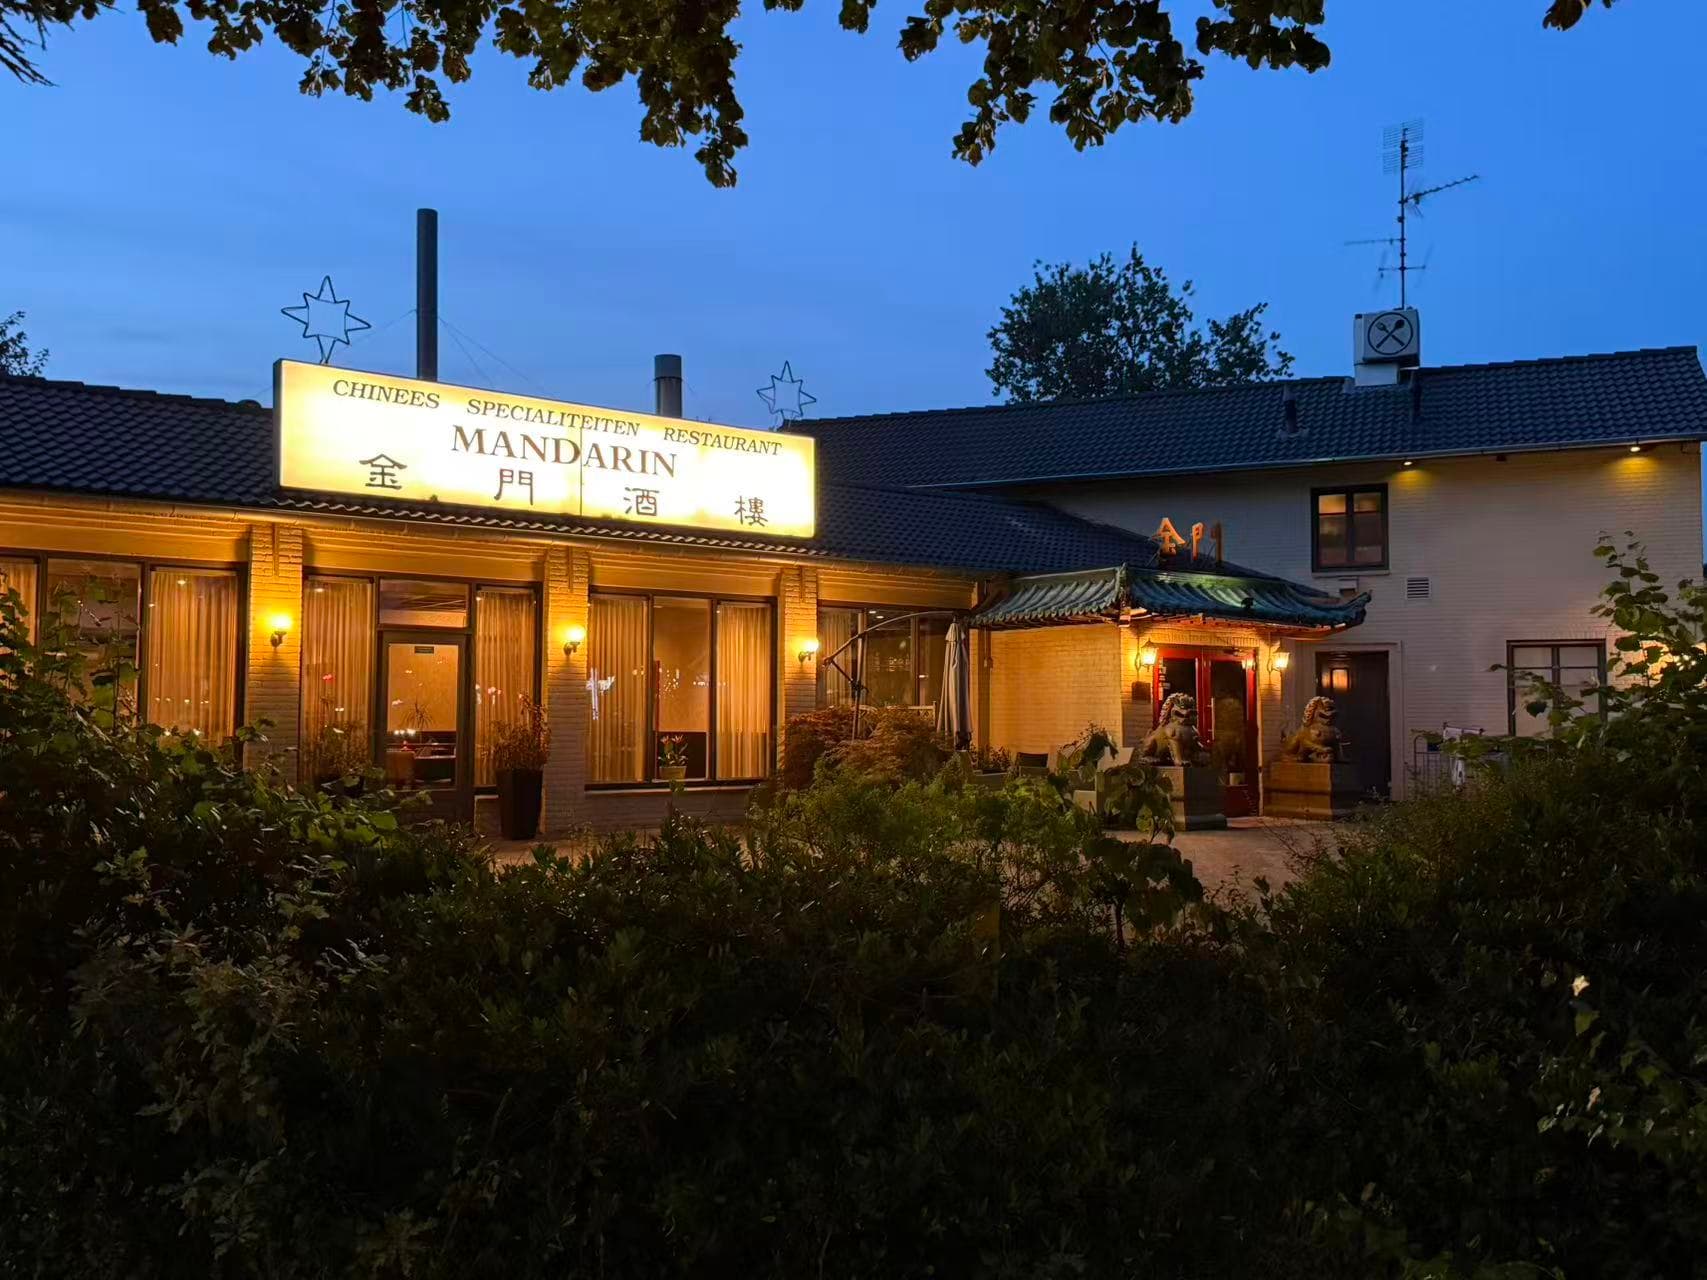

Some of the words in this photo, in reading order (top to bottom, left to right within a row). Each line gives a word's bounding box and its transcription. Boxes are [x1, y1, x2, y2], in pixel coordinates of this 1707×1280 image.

[333, 379, 440, 409] CHINEES
[466, 398, 640, 437] SPECIALITEITEN
[663, 427, 783, 456] RESTAURANT
[452, 424, 677, 478] MANDARIN
[358, 453, 769, 527] 金門酒樓
